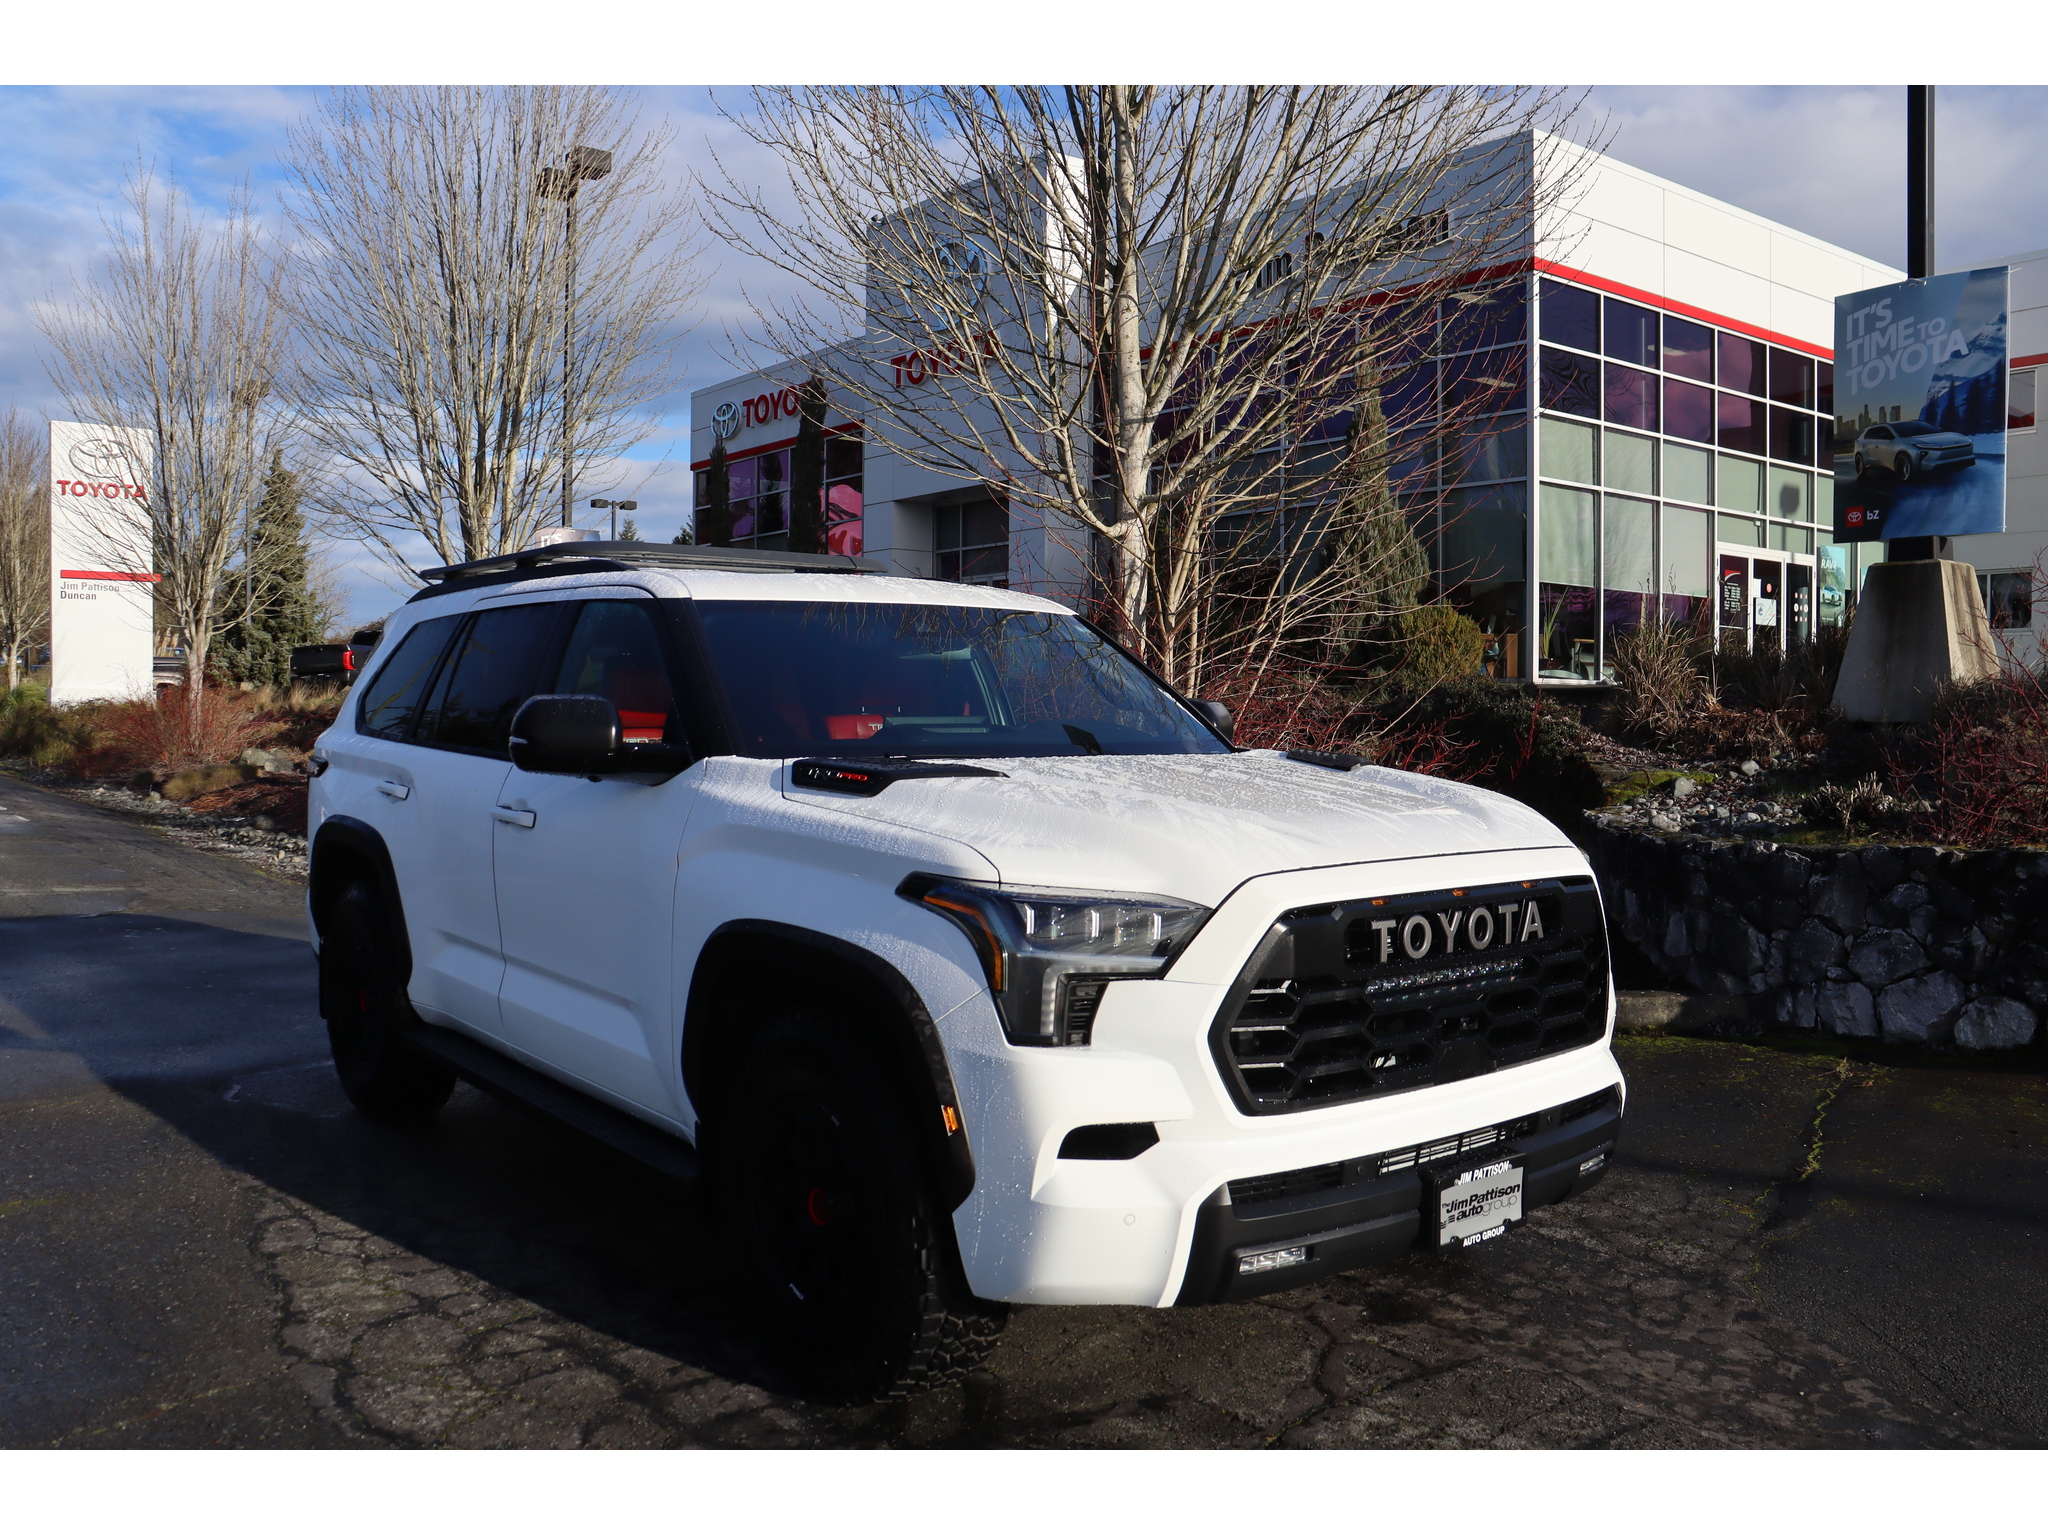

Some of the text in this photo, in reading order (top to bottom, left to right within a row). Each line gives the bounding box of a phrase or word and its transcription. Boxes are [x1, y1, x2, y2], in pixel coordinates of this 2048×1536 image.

[1847, 298, 1893, 342] IT'S
[1847, 316, 1946, 368] TIME TO
[1846, 329, 1970, 396] TOYOTA
[743, 378, 827, 427] TOYO
[57, 479, 148, 500] TOYOTA
[60, 581, 120, 592] Jim Pattison
[60, 591, 97, 600] Duncan
[1371, 900, 1544, 963] TOYOTA
[1458, 1160, 1510, 1186] JIM PATTISON
[1463, 1225, 1505, 1247] AUTO GROUP
